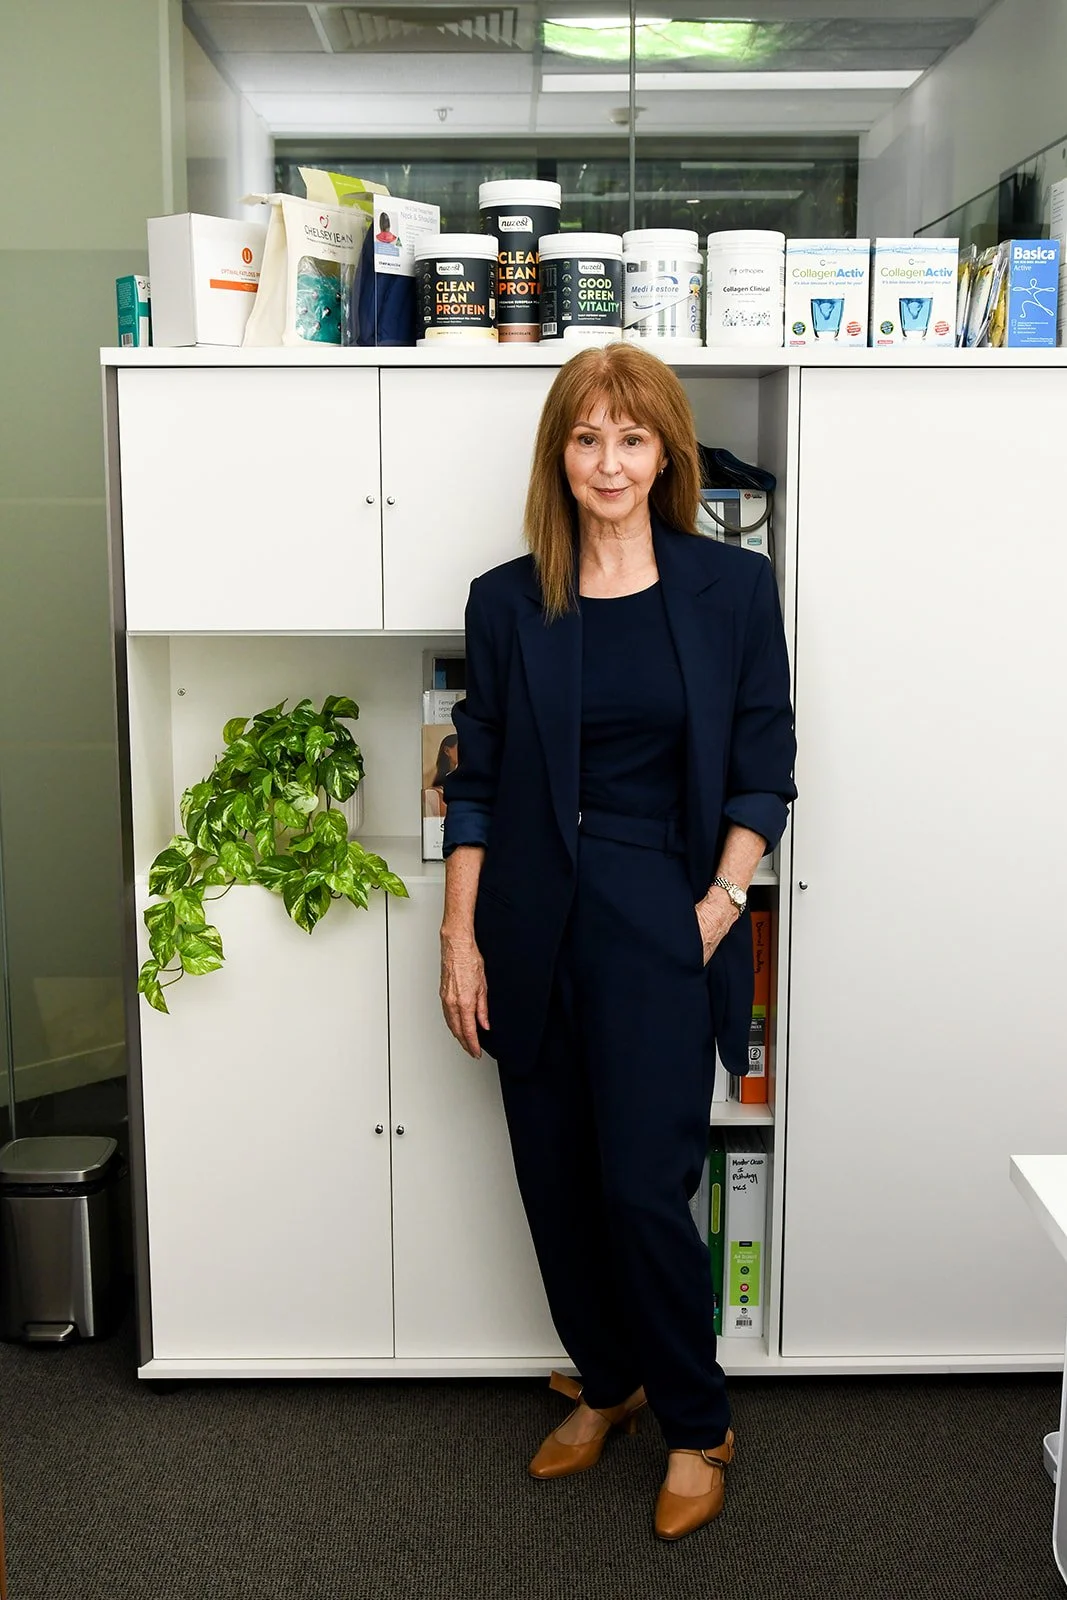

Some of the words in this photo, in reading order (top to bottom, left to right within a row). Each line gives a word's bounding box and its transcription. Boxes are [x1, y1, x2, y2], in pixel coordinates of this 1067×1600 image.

[501, 217, 529, 227] nuzest
[1013, 246, 1055, 261] Basica
[498, 267, 536, 280] LEAN
[880, 267, 953, 279] CollagenActiv
[1013, 264, 1032, 272] Active
[792, 268, 865, 280] CollagenActiv
[435, 281, 475, 292] CLEAN
[578, 278, 612, 290] GOOD
[723, 285, 749, 294] Collagen
[436, 292, 467, 303] LEAN
[578, 290, 614, 301] GREEN
[436, 304, 485, 315] PROTEIN
[578, 301, 619, 312] VITALITY
